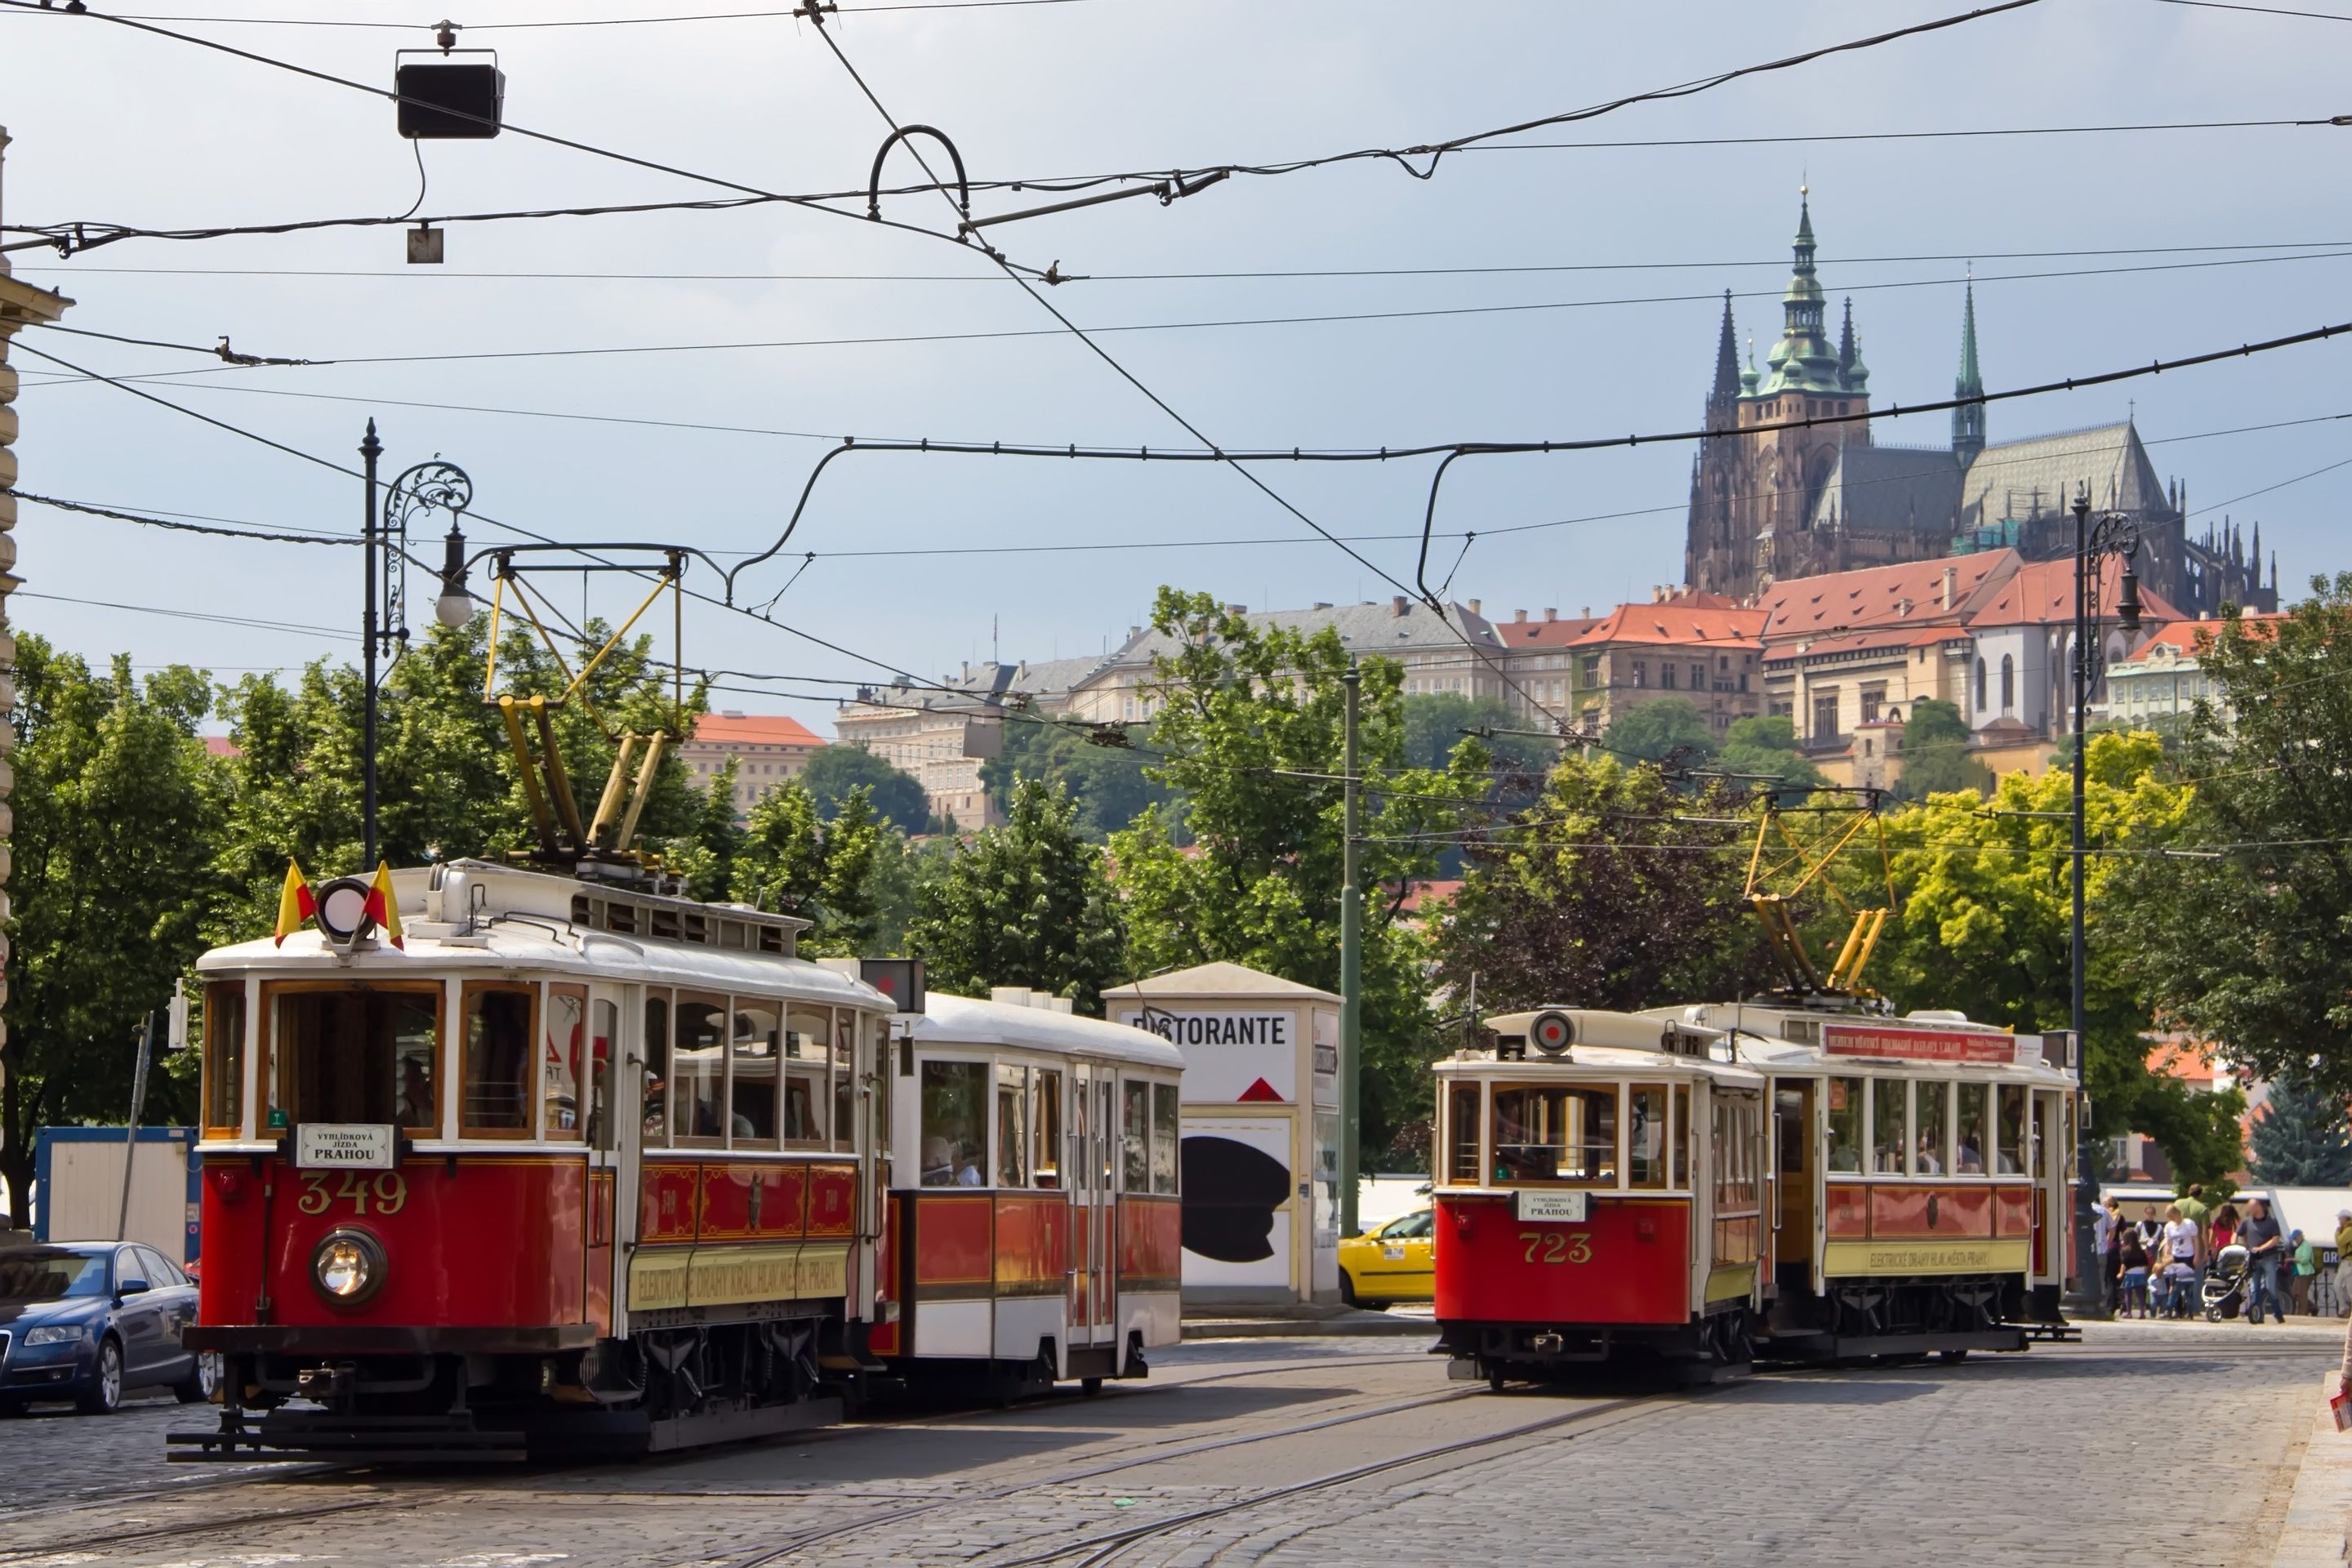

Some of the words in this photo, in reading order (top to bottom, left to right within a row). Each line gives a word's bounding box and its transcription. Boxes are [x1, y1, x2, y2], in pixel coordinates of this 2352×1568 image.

[318, 1133, 373, 1141] VYHLÍDKOVÁ
[332, 1140, 358, 1148] JÍZDA
[314, 1149, 375, 1160] PRAHOU
[298, 1170, 408, 1214] 349
[1519, 1233, 1592, 1263] 723
